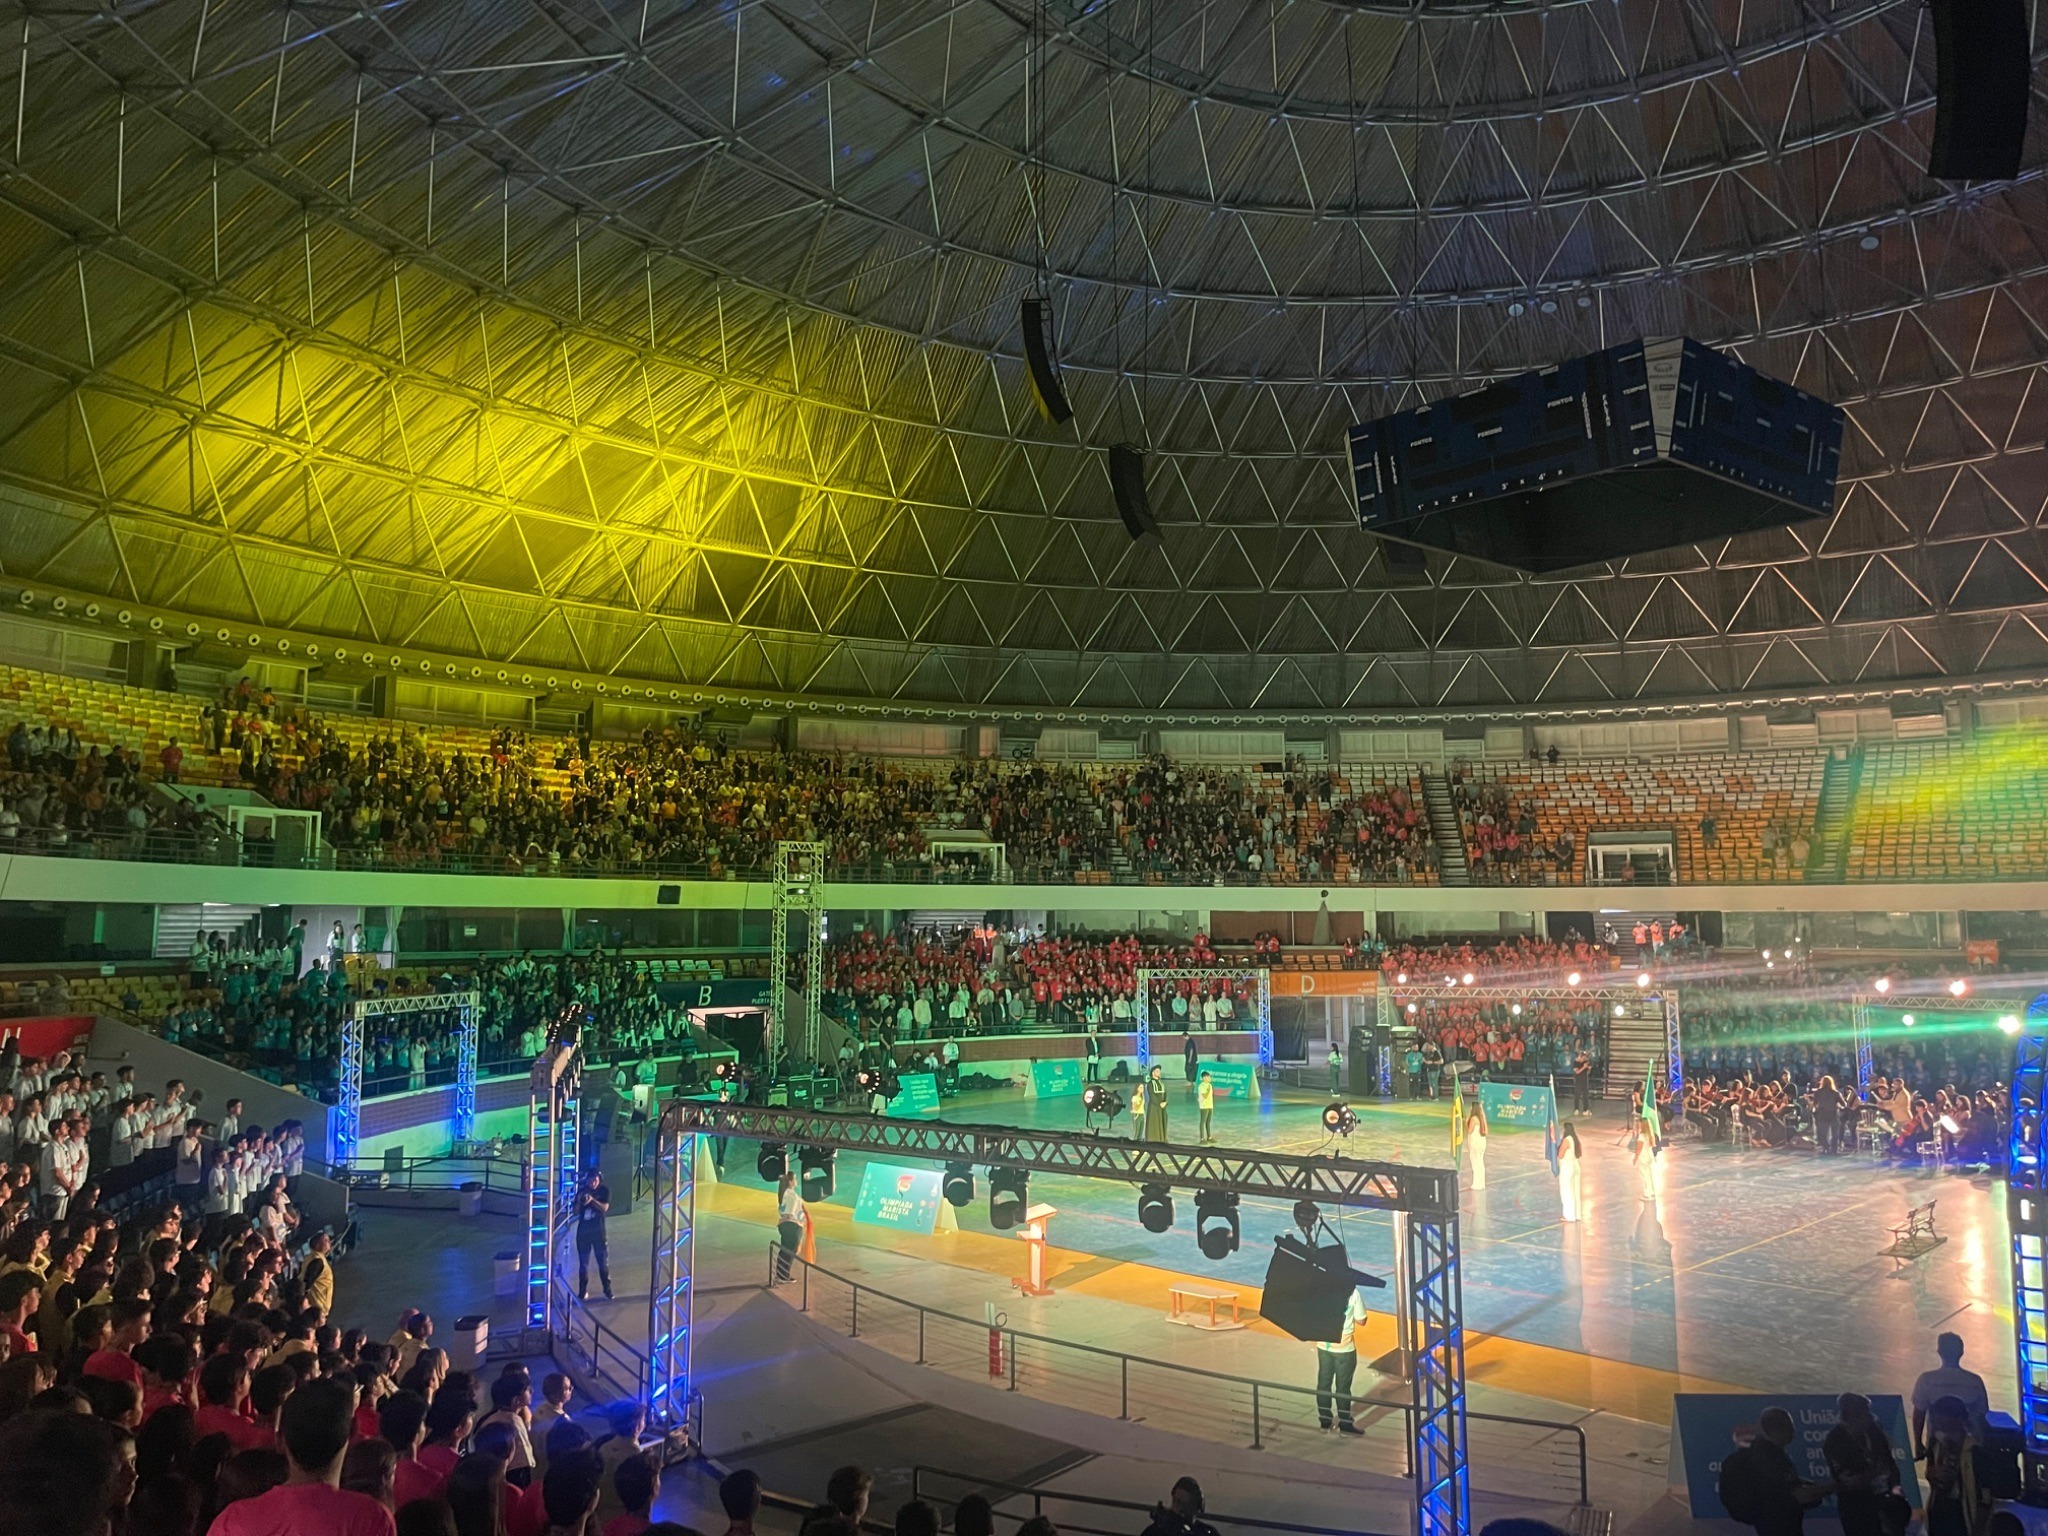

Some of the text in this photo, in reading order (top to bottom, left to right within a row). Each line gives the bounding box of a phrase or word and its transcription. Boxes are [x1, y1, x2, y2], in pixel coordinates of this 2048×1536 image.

[1547, 395, 1573, 408] PONTOS
[1410, 437, 1432, 447] PONTOS
[1301, 975, 1315, 994] D
[698, 985, 712, 1007] B
